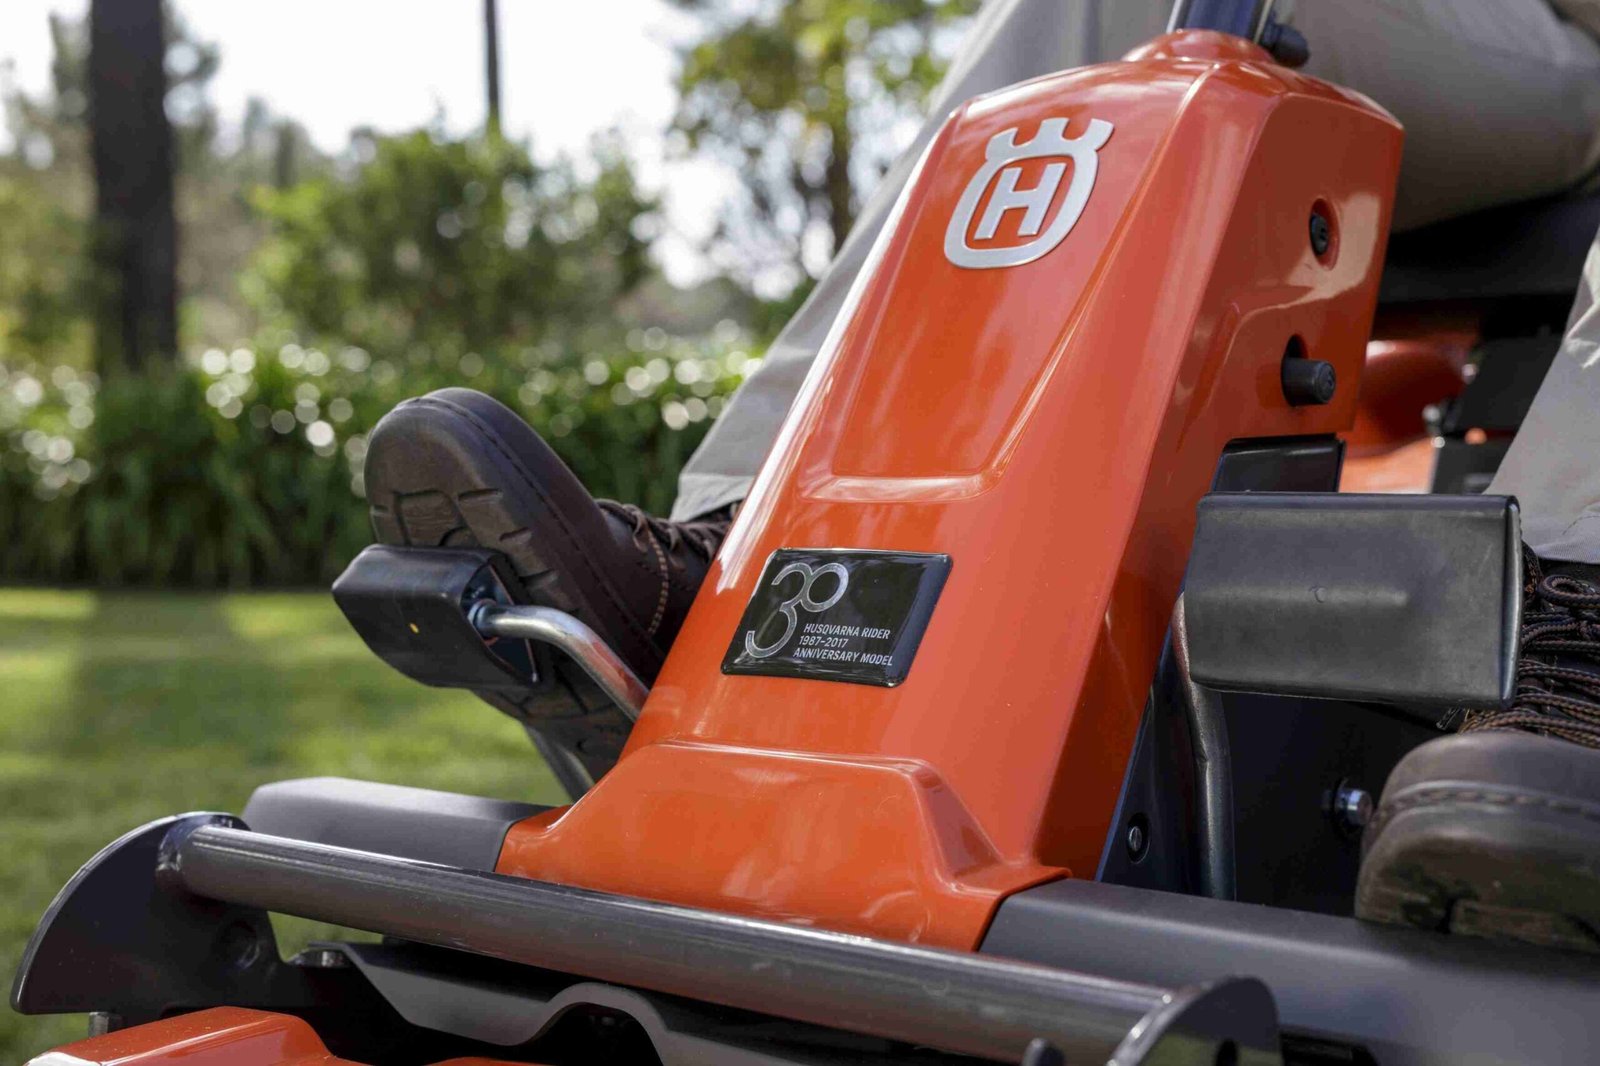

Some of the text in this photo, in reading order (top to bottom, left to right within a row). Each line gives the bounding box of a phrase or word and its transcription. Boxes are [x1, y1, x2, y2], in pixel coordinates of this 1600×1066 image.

[745, 562, 849, 659] 30
[803, 623, 891, 640] HUSQVARNA RIDER
[799, 635, 849, 649] 1987-2017
[793, 648, 893, 666] ANNIVERSARY MODEL
